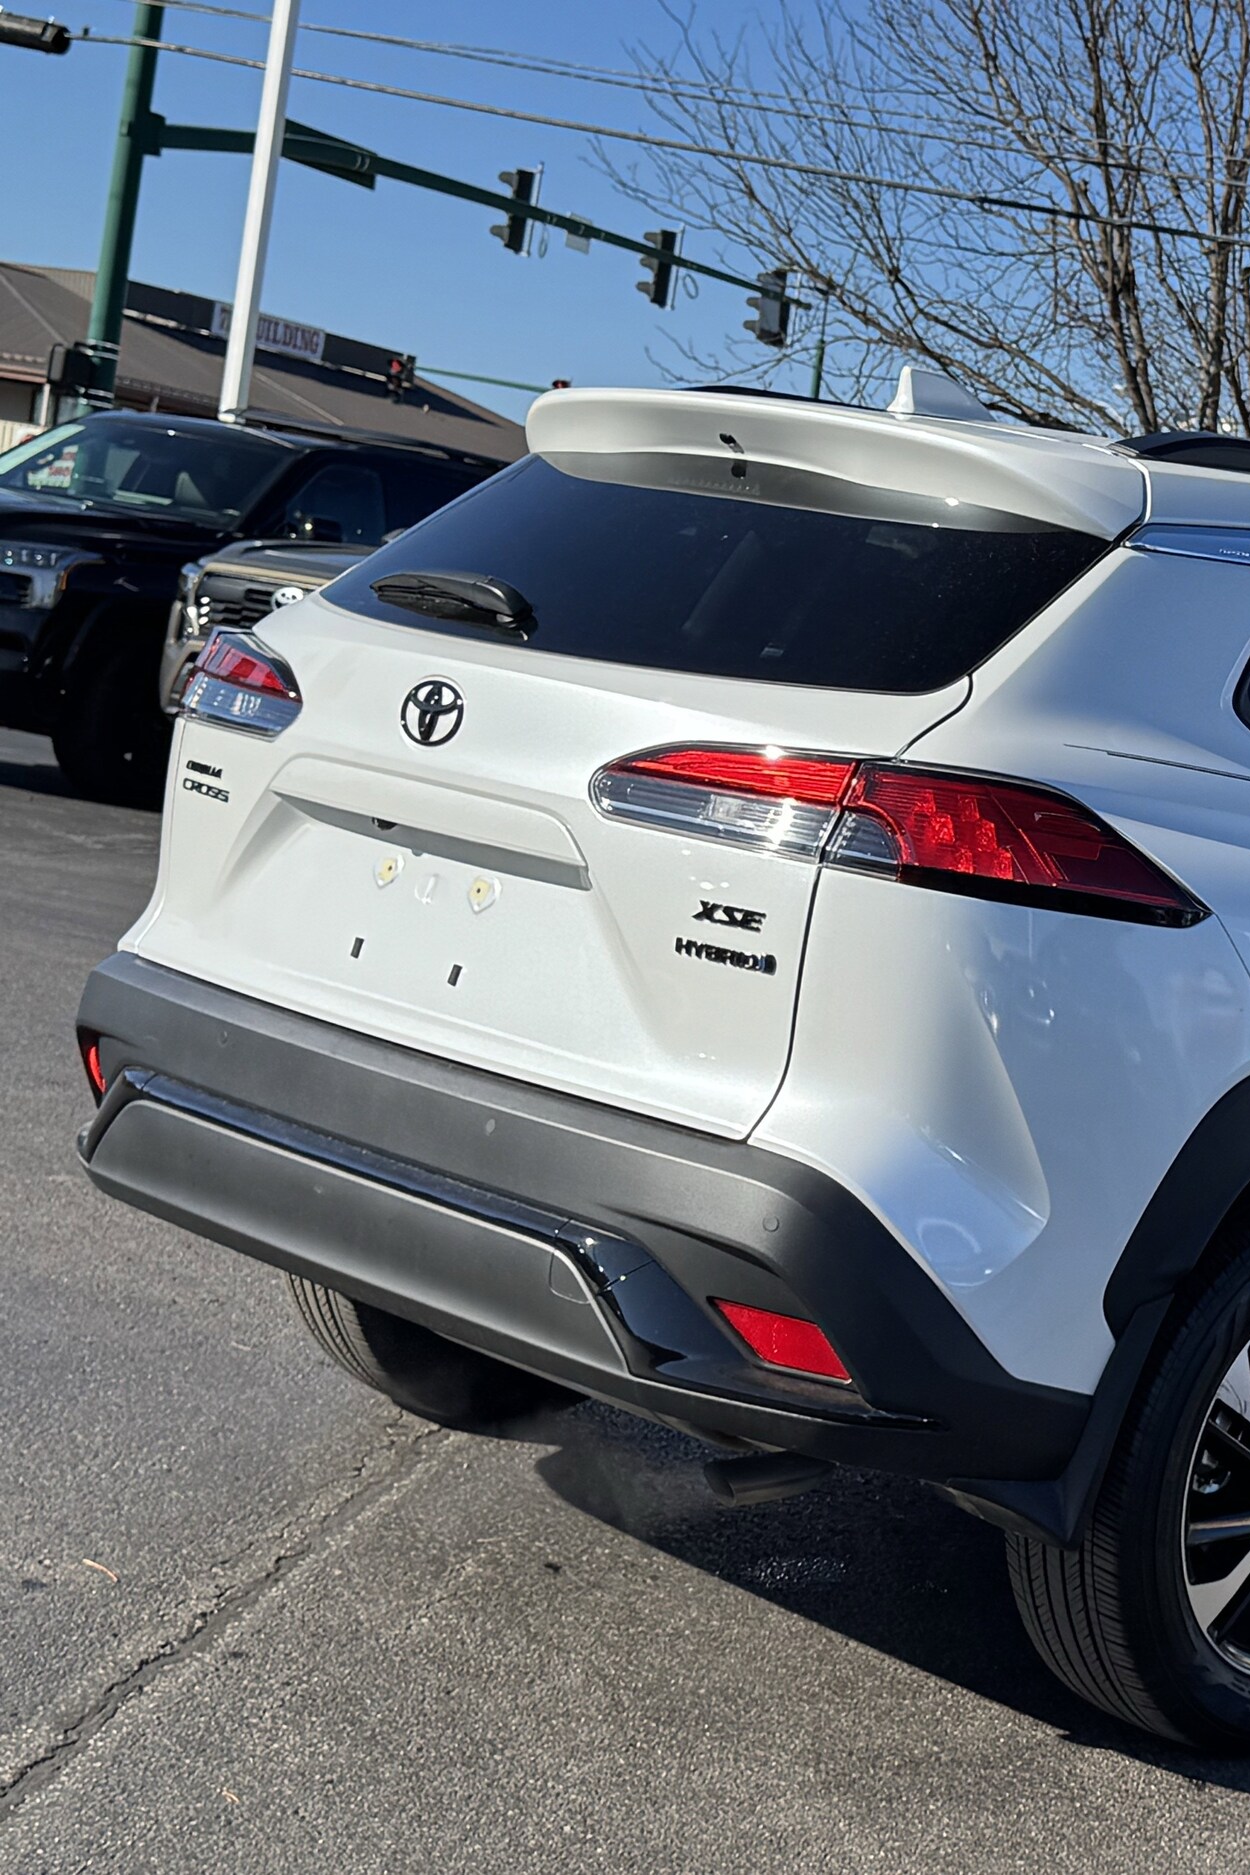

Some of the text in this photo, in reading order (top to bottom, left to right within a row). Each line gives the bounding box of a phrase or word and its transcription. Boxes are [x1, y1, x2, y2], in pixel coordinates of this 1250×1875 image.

[255, 318, 320, 354] UILDING
[182, 777, 230, 803] CROSS
[691, 899, 767, 933] XSE
[675, 936, 761, 972] HYBRID
